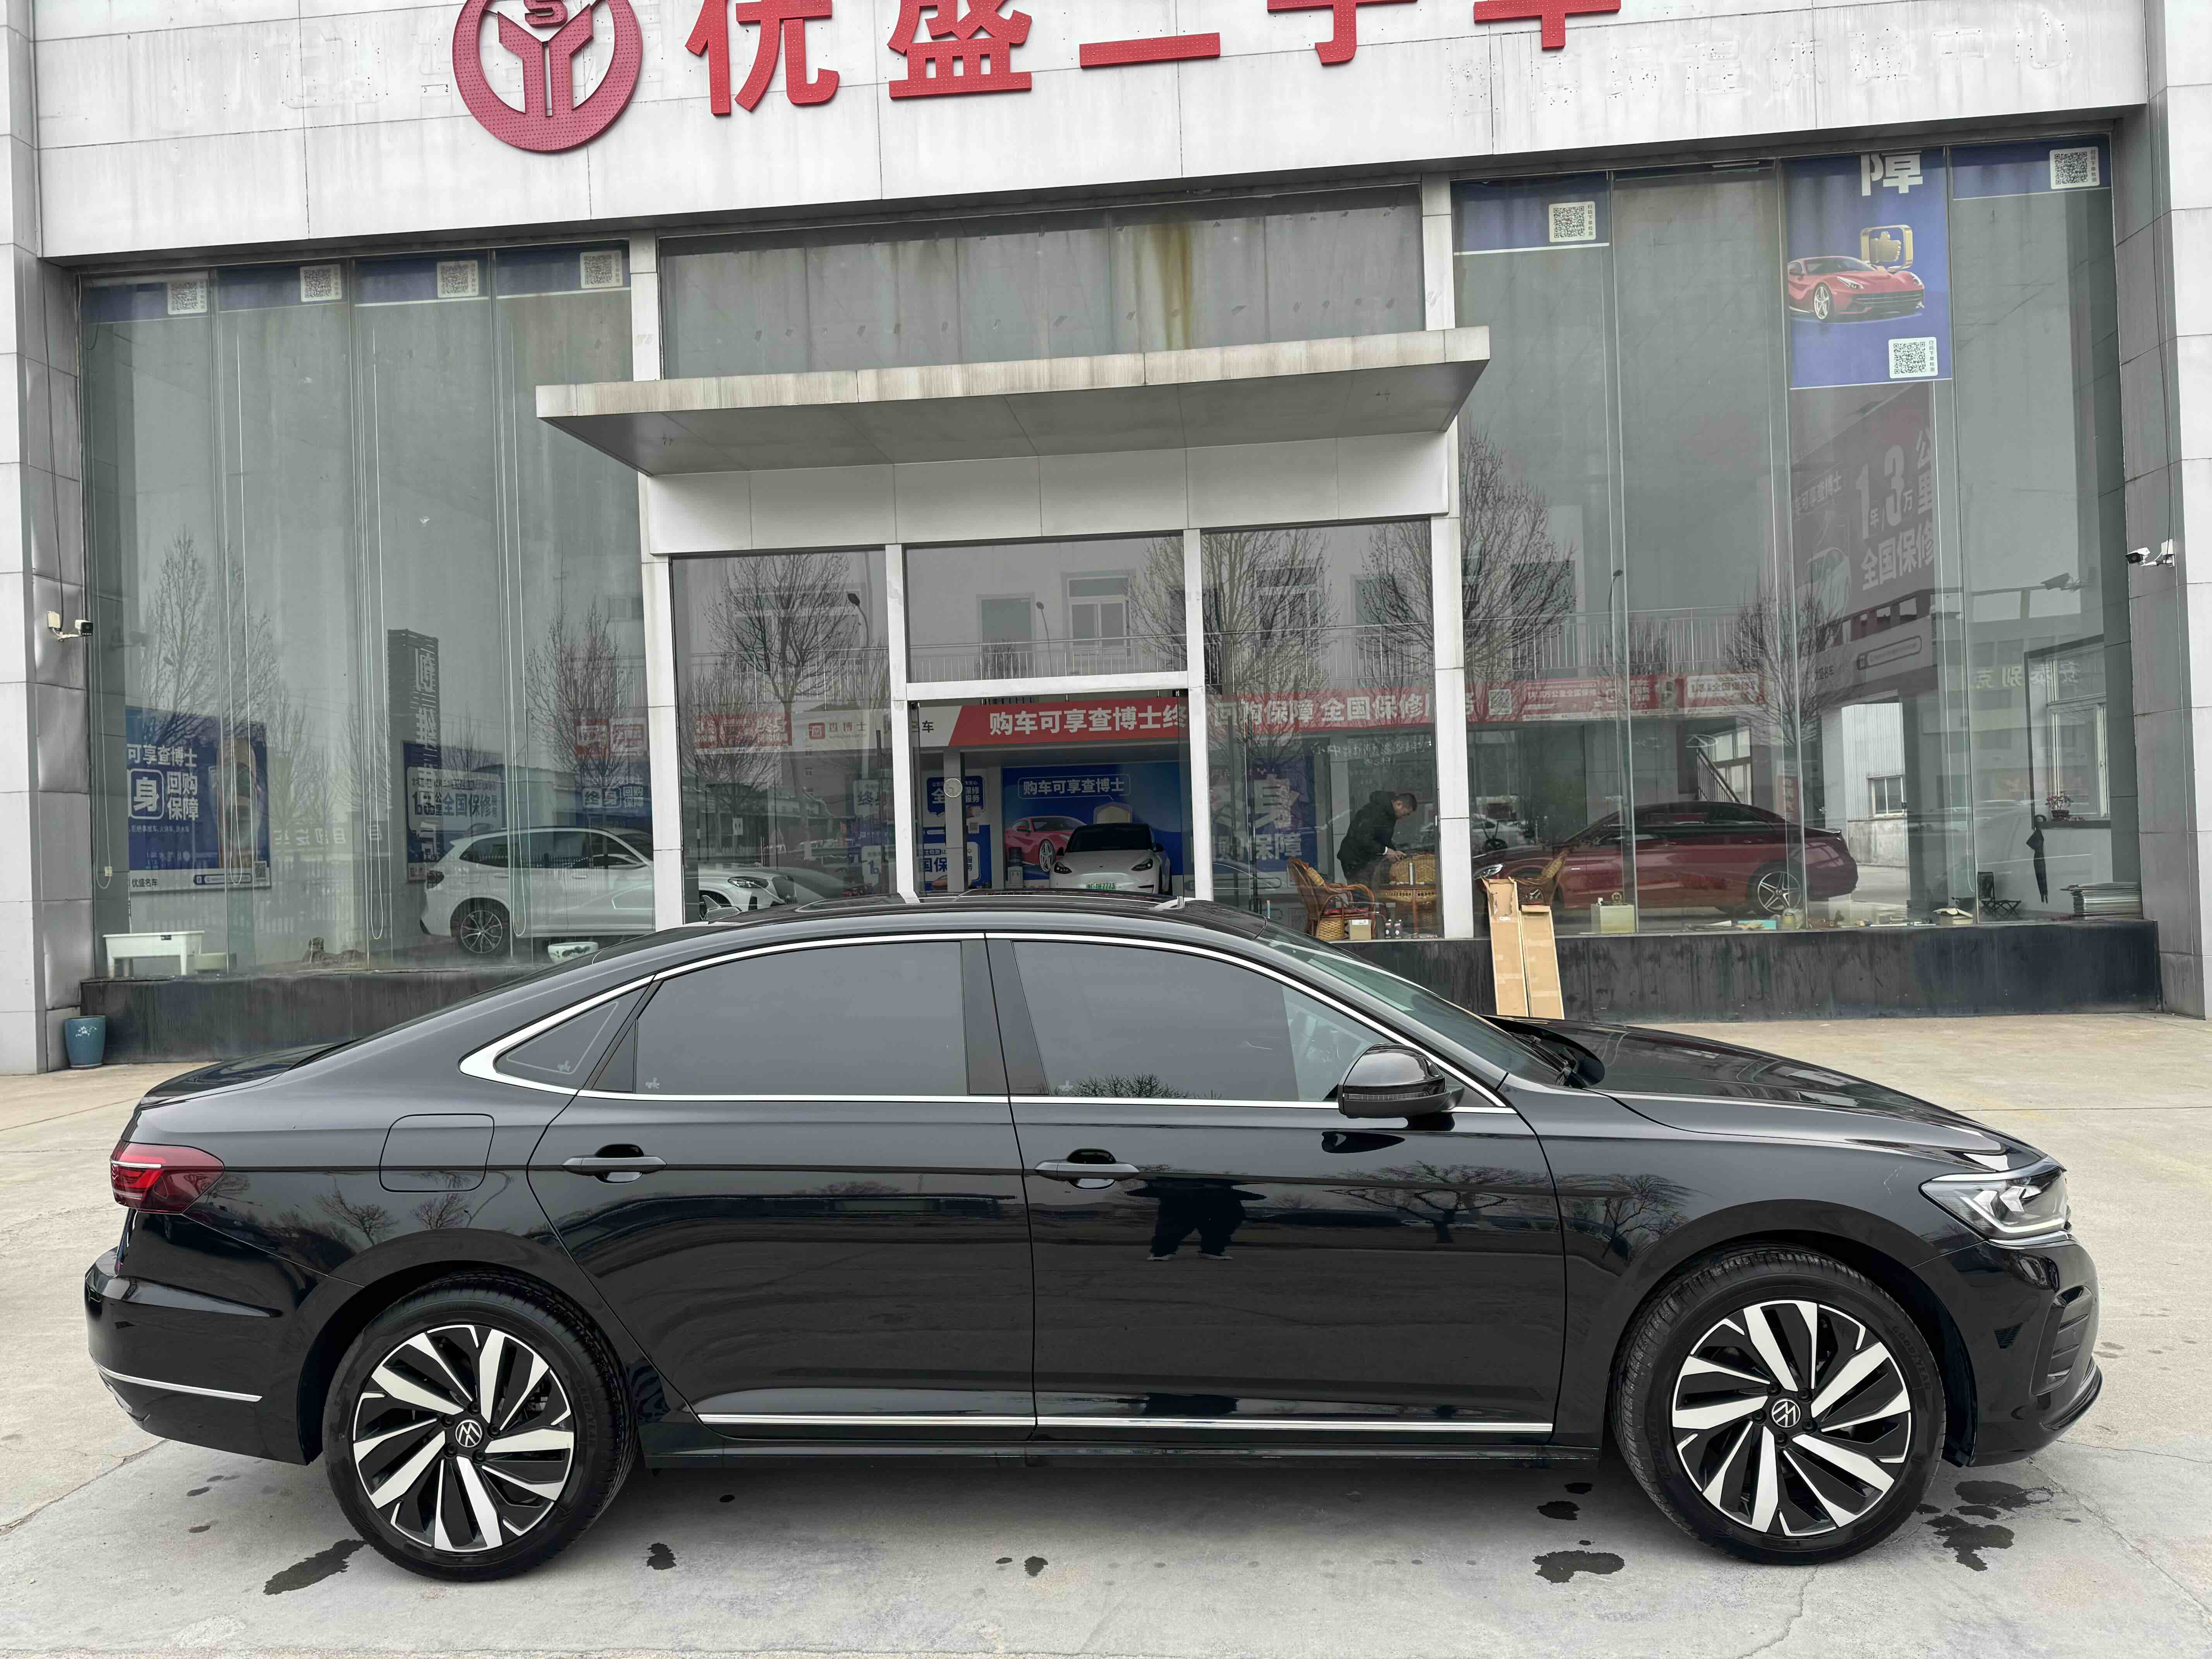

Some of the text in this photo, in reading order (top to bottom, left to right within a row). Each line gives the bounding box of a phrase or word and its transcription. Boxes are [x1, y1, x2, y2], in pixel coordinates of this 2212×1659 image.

[127, 744, 197, 768] 可享查博士
[133, 771, 198, 812] 身 回购
[1023, 778, 1125, 795] 购车可享查博士
[167, 797, 198, 821] 保障
[1892, 1325, 1932, 1390] GOODYEAR
